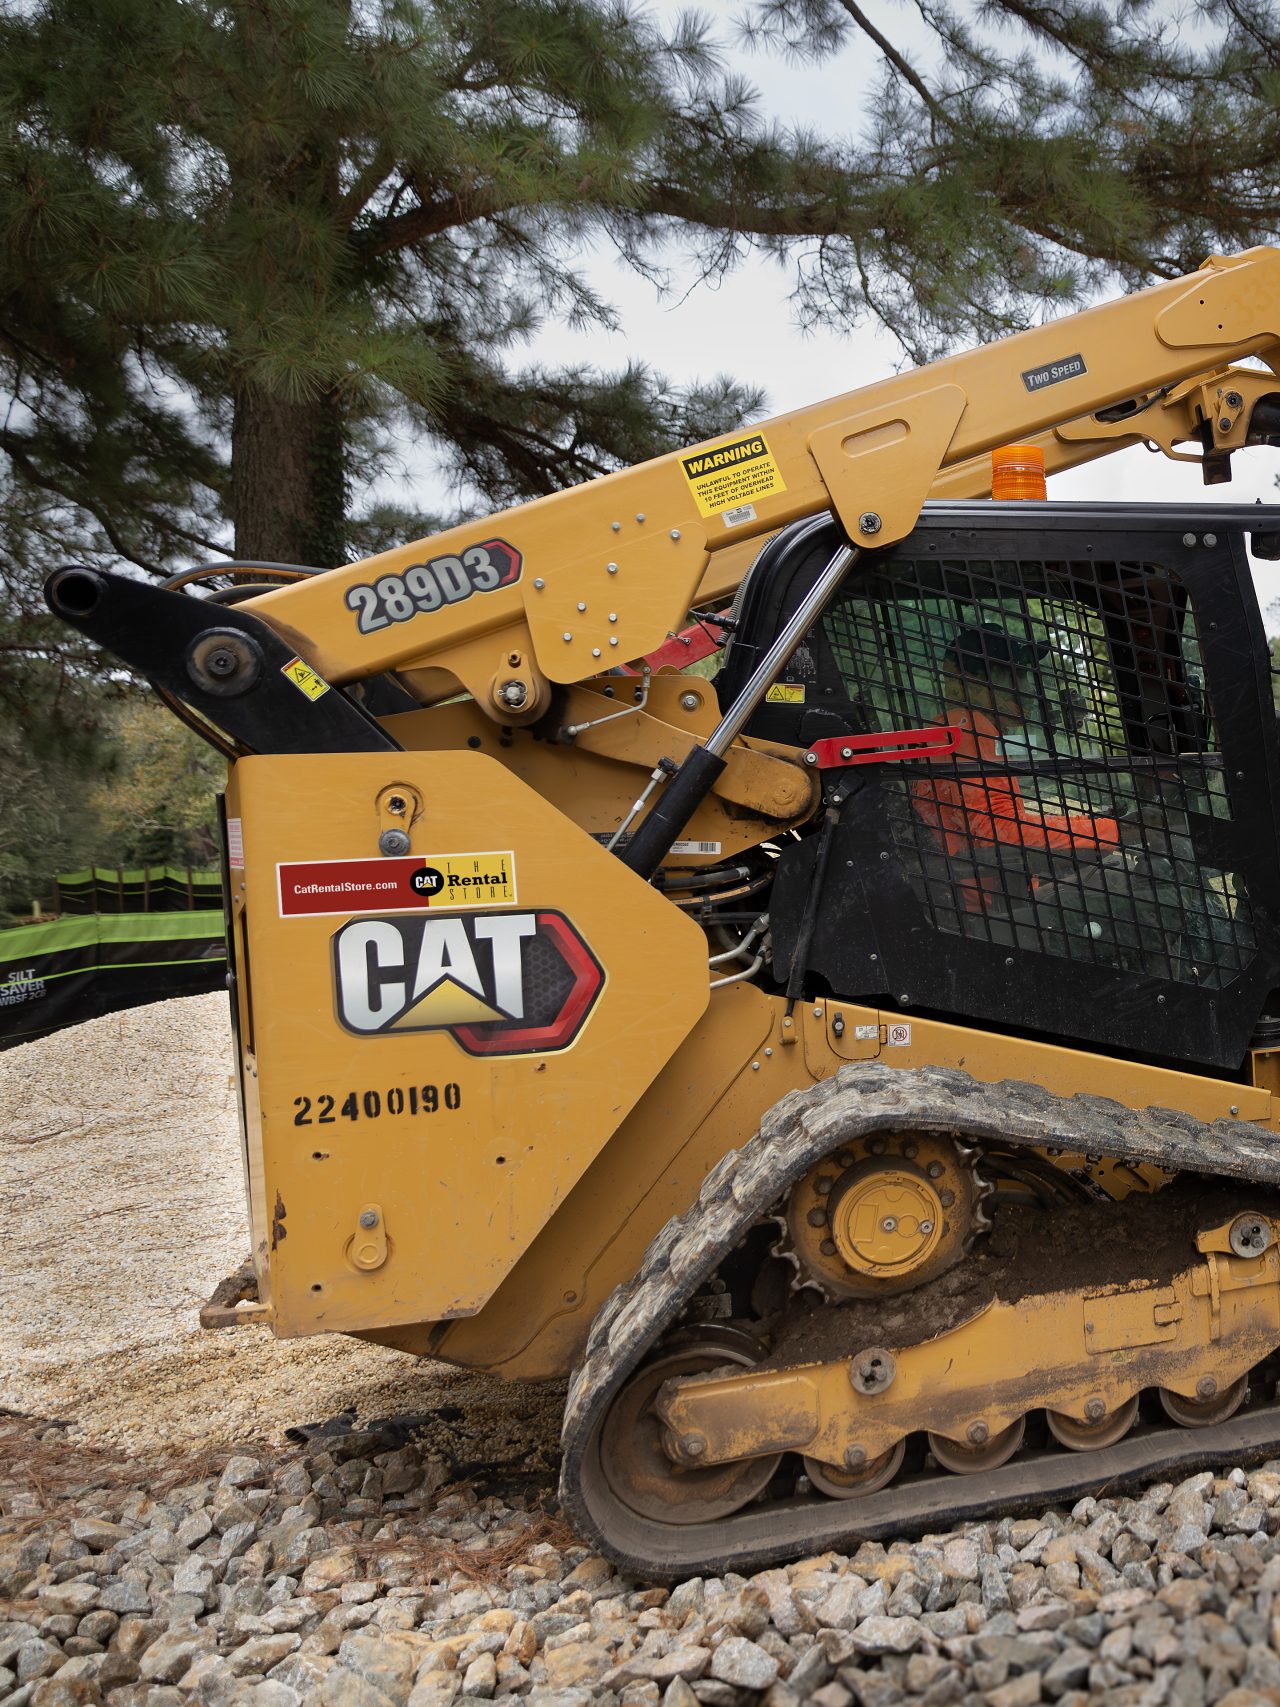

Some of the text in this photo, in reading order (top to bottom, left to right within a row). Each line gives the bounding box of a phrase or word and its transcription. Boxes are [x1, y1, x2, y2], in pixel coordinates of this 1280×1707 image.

[688, 441, 763, 475] WARNING
[696, 476, 731, 490] UNLAWFUL
[742, 462, 771, 476] OPERATE
[698, 467, 775, 497] THIS EQUIPMENT WITHIN
[713, 490, 729, 499] FEET
[740, 475, 774, 490] OVERHEAD
[709, 482, 775, 509] HIGH VOLTAGE LINES
[348, 547, 500, 632] 289D3
[446, 859, 506, 874] THE
[293, 872, 508, 895] CatRentalStore.com CAT Rental
[449, 886, 508, 901] STORE
[8, 968, 36, 983] SILT
[338, 913, 537, 1031] CAT
[0, 979, 45, 996] SAVER
[293, 1082, 462, 1127] 22400190
